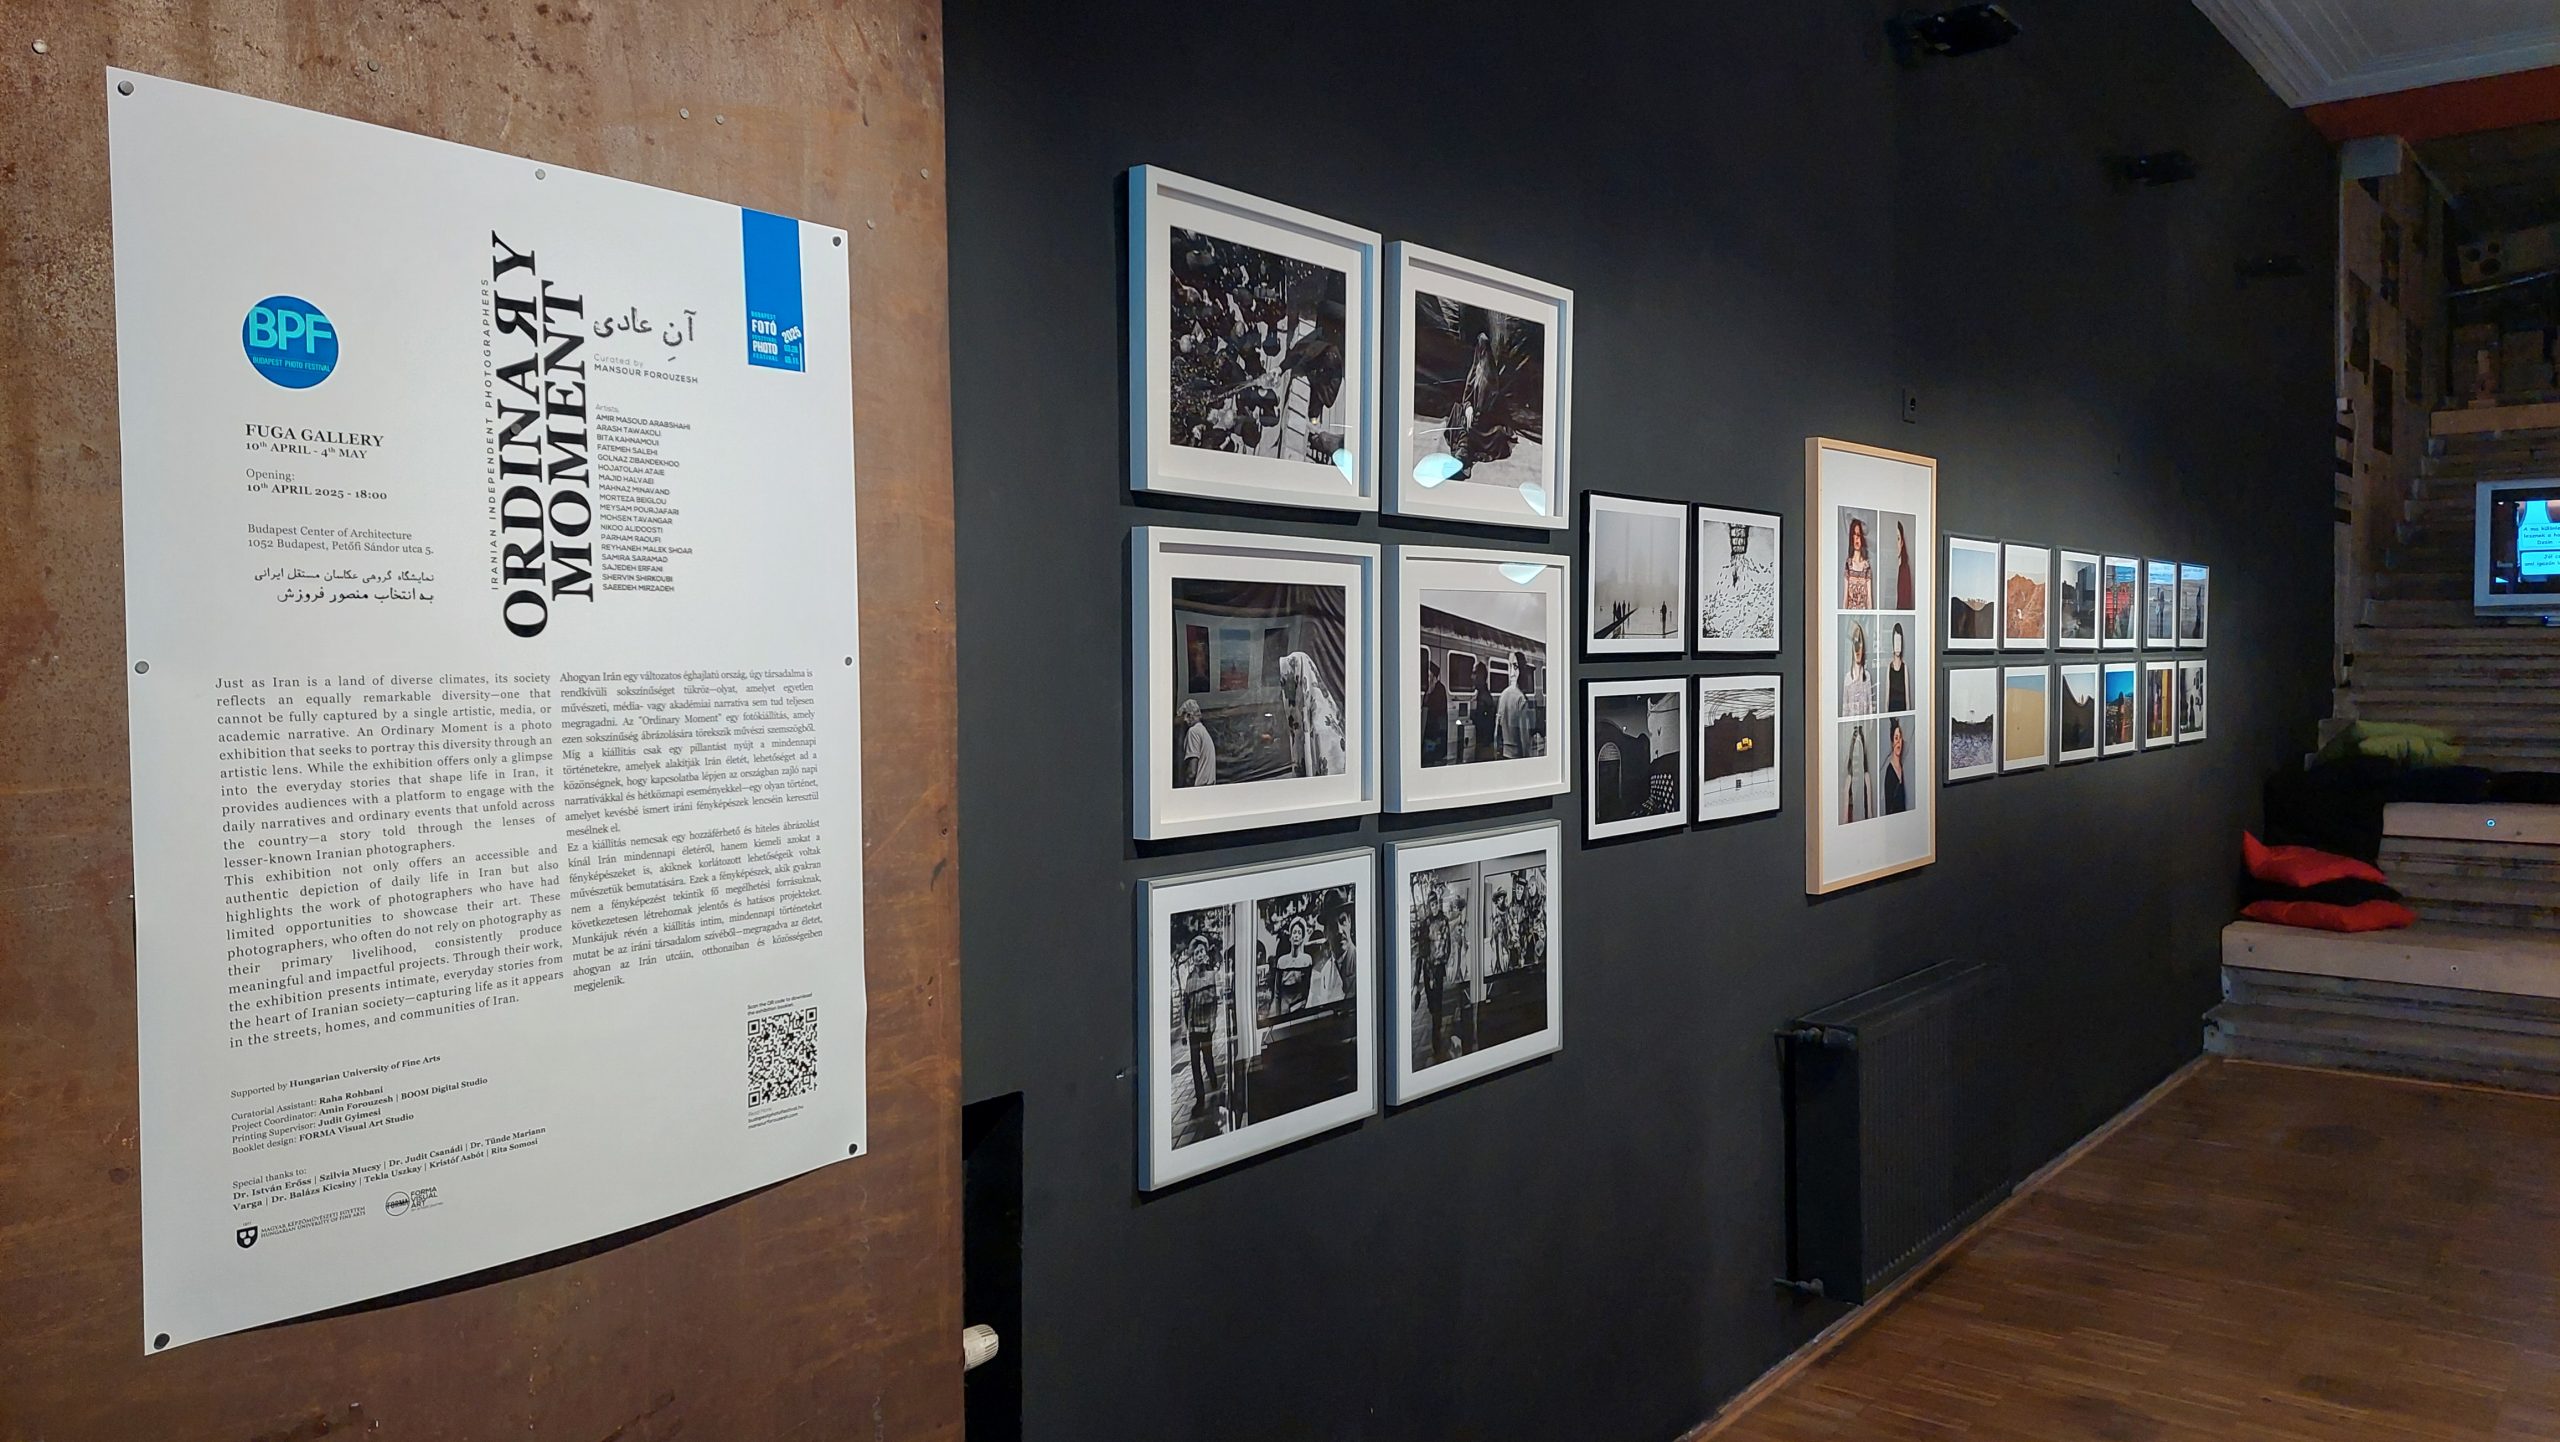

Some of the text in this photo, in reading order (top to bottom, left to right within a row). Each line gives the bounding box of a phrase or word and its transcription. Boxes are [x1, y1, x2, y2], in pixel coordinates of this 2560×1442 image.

[248, 306, 332, 354] BPF
[751, 318, 778, 336] FOTÓ
[781, 325, 802, 344] 2025
[752, 340, 779, 355] PHOTO
[593, 353, 630, 366] Curated
[594, 363, 698, 383] MANSOUR FOROUZESH
[246, 423, 383, 447] FUGA GALLERY
[480, 279, 499, 590] IRANIAN INDEPENDENT PHOTOGRAPHERS
[541, 279, 594, 602] MOMENT
[246, 441, 267, 450] 10th
[270, 443, 311, 454] APRIL
[320, 446, 335, 458] 4th
[339, 448, 367, 459] MAY
[596, 443, 658, 456] FATEMEH SALEHI
[245, 468, 295, 483] Opening:
[247, 482, 268, 492] 10th
[271, 484, 312, 495] APRIL
[314, 488, 344, 499] 2025
[355, 489, 387, 500] 18:00
[599, 513, 672, 524] MOHSEN TAVANGAR
[248, 523, 412, 540] Budapest Center of Architecture
[600, 533, 661, 543] PARHAM RAOUFI
[248, 538, 434, 555] 1052 Budapest, Petőfi Sándor utca 5.
[215, 672, 550, 689] Just as Iran is a land of diverse climates, its society
[216, 687, 551, 707] reflects an equally remarkable diversity—one that
[216, 704, 551, 725] cannot be fully captured by a single artistic, media, or
[223, 839, 454, 868] lesser-known Iranian photographers.
[229, 995, 518, 1049] in the streets, homes, and communities of Iran.
[230, 1055, 440, 1098] Supported by Hungarian University of Fine Arts
[231, 1077, 487, 1132] Project Coordinator: Amin Forouzesh BOOM Digital Studio
[410, 1186, 437, 1196] FORMA
